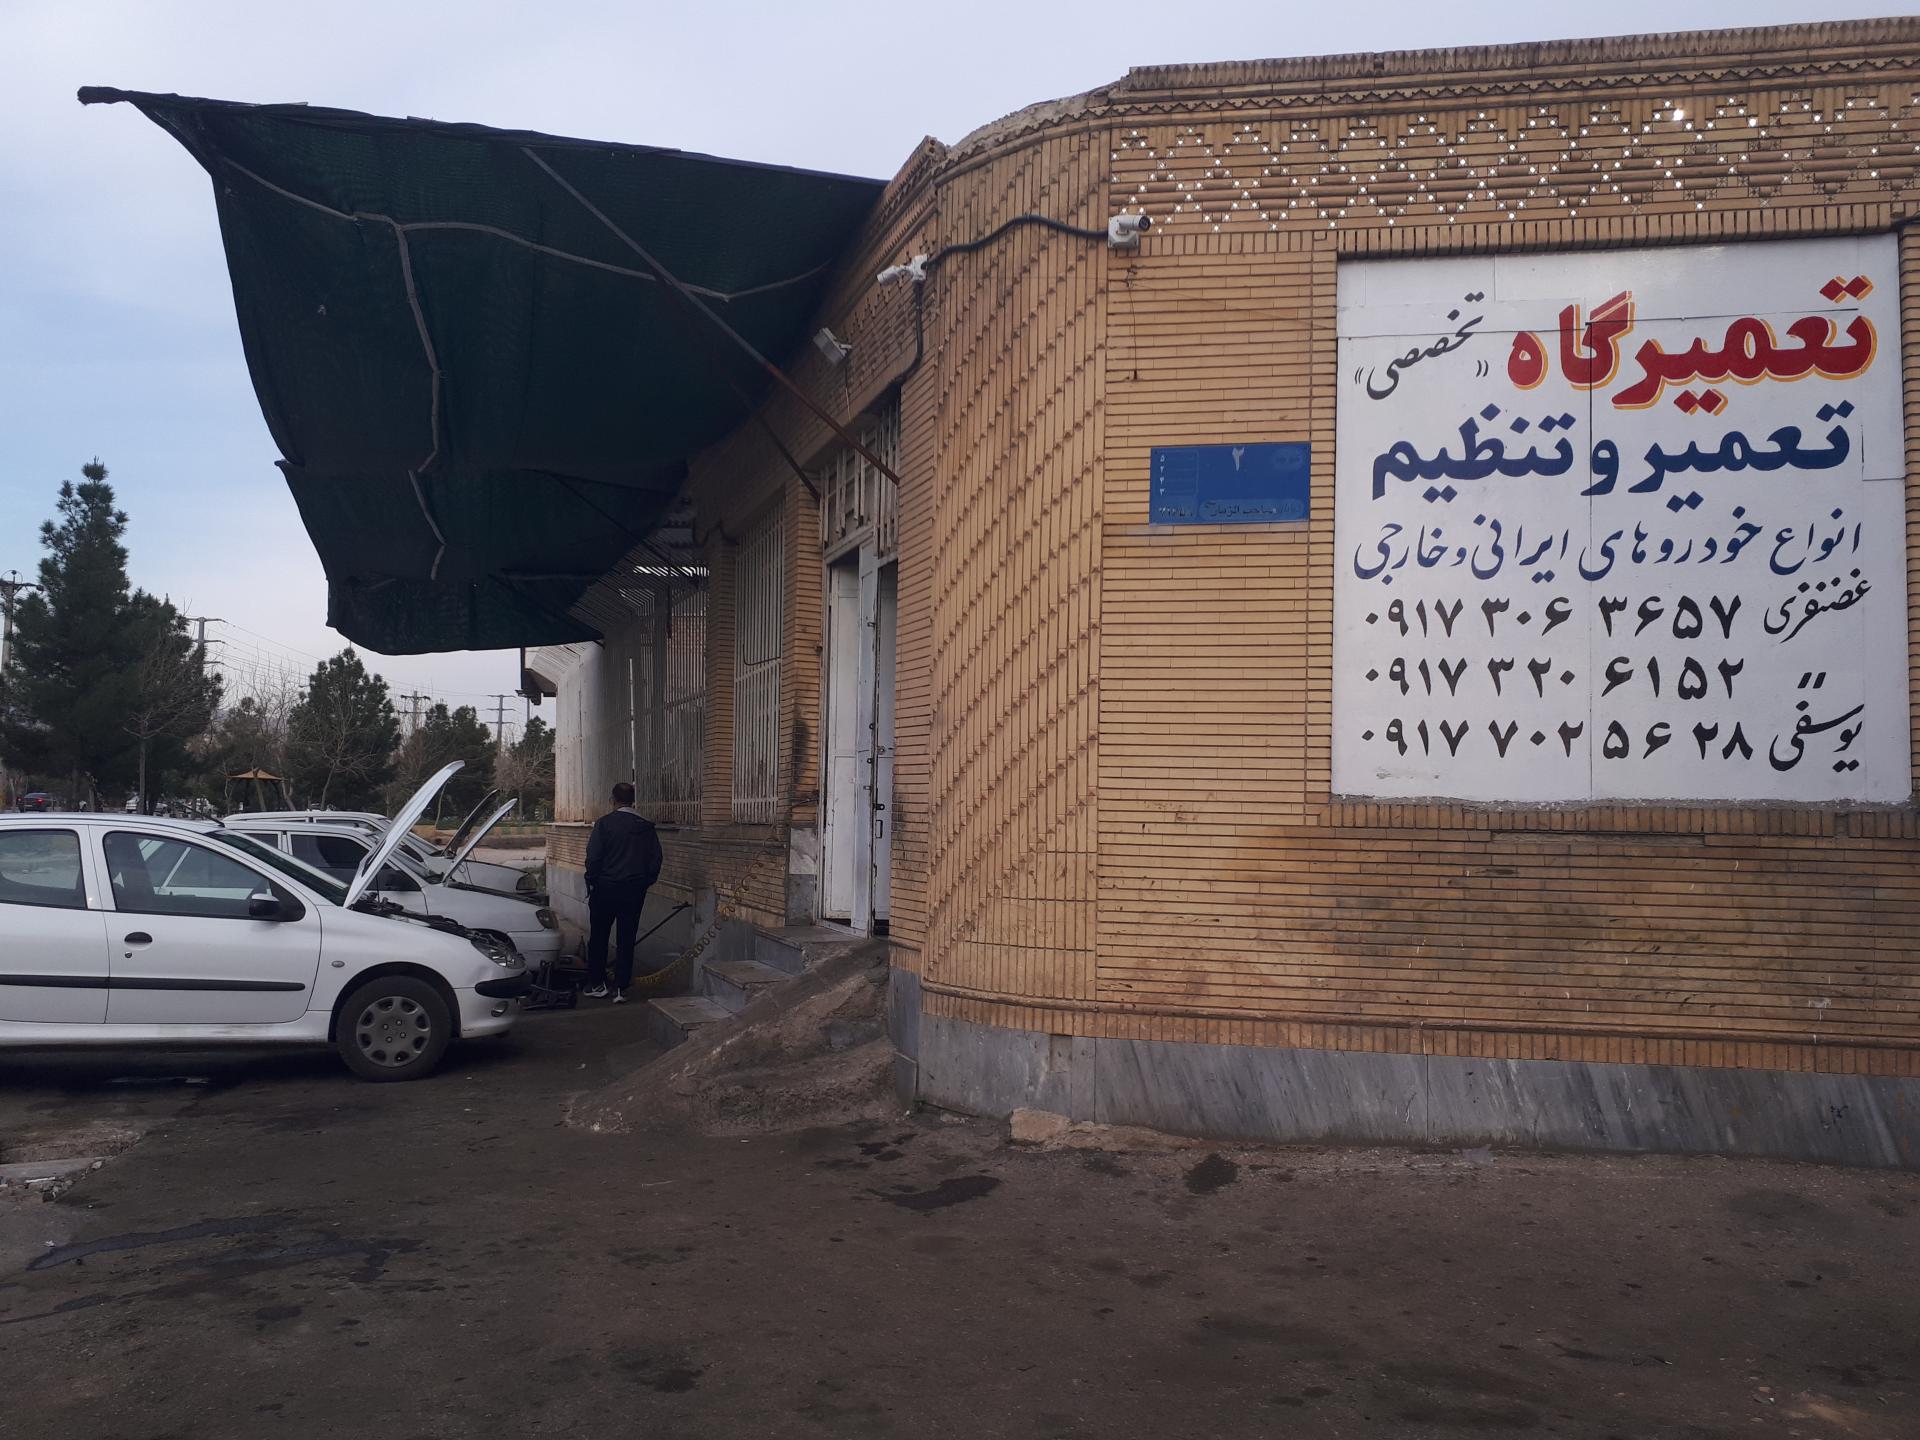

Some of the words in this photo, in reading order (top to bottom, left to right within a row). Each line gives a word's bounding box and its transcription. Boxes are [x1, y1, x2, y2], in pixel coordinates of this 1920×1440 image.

[1507, 275, 1878, 416] تعمیرگاه
[1372, 402, 1577, 504] تنظیم
[1581, 440, 1620, 497] و
[1628, 399, 1855, 513] تعمیر
[1353, 522, 1449, 585] خارجی
[1449, 547, 1467, 567] و
[1471, 513, 1570, 584] ایرانی
[1769, 507, 1862, 576] انواع
[1768, 700, 1865, 773] یوسفی
